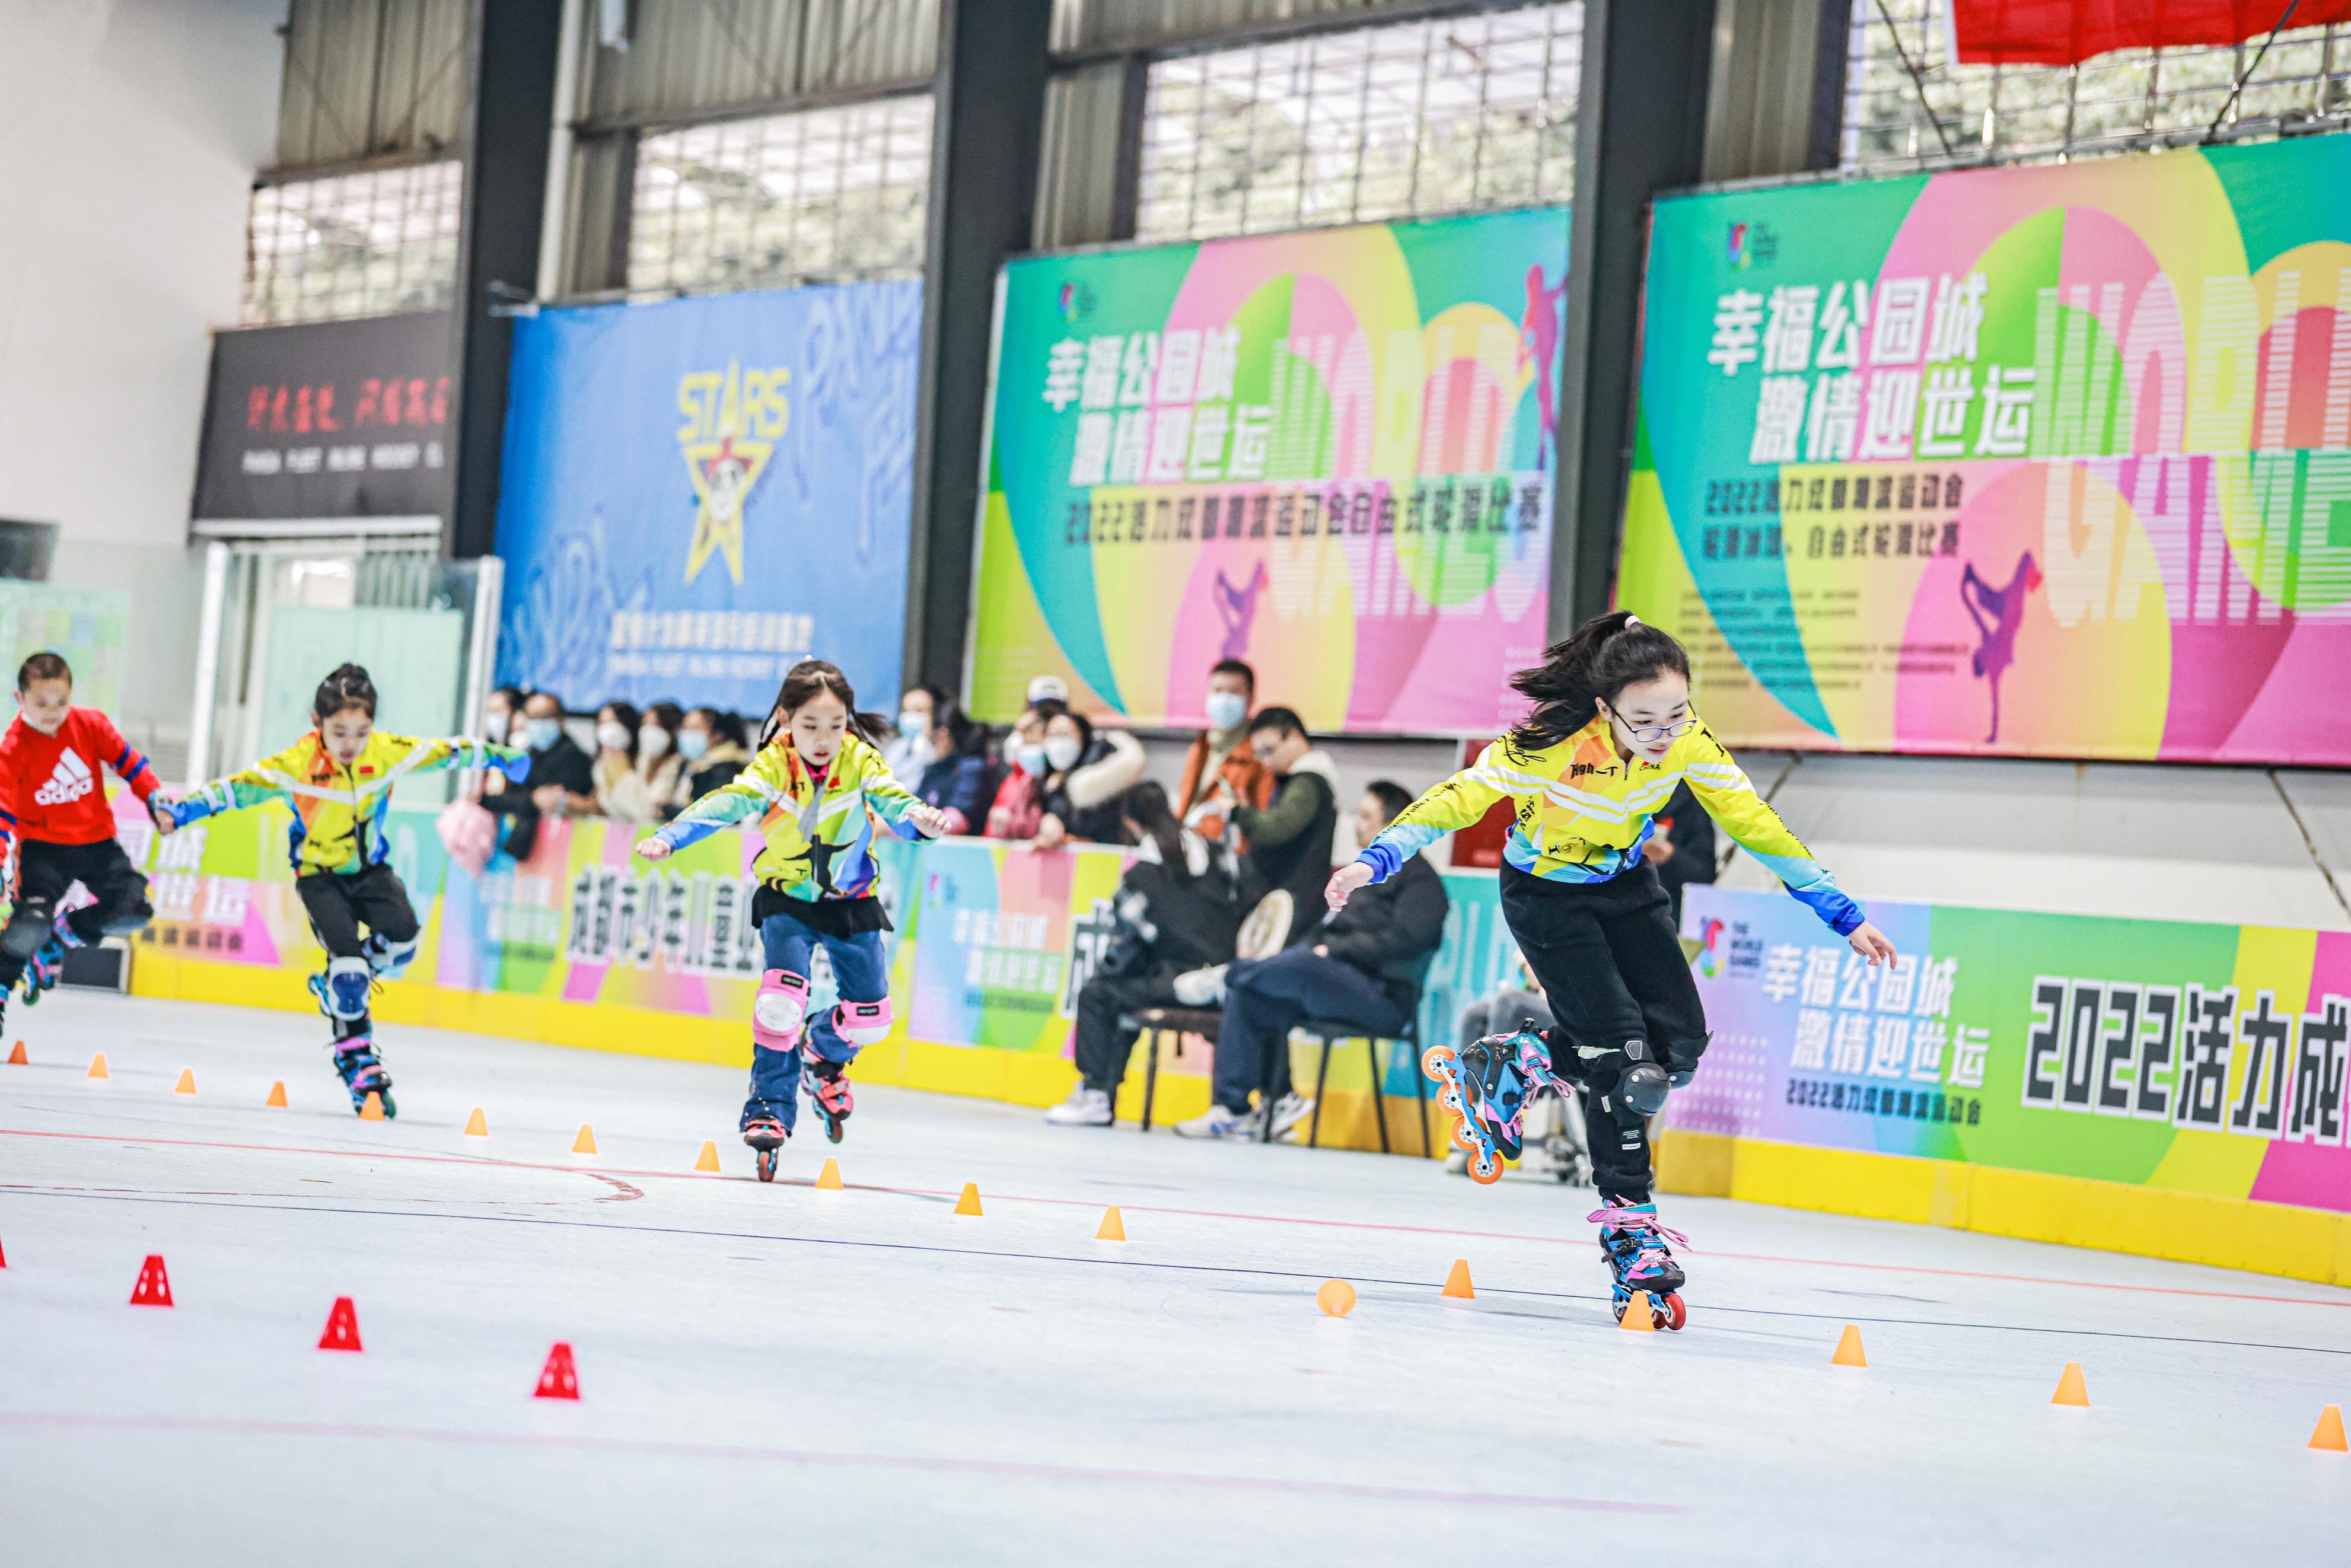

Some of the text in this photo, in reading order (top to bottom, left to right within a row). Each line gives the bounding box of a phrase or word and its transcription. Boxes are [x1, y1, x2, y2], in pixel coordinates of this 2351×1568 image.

[1707, 272, 1988, 377] 幸福公园城
[677, 358, 791, 443] STARS
[1042, 326, 1242, 414] 幸福公园城
[1749, 364, 2036, 465] 激情迎世运
[1761, 942, 1958, 1019] 幸福公园城
[1791, 1008, 1991, 1089] 激情迎世运
[2021, 974, 2351, 1149] 2022活力成
